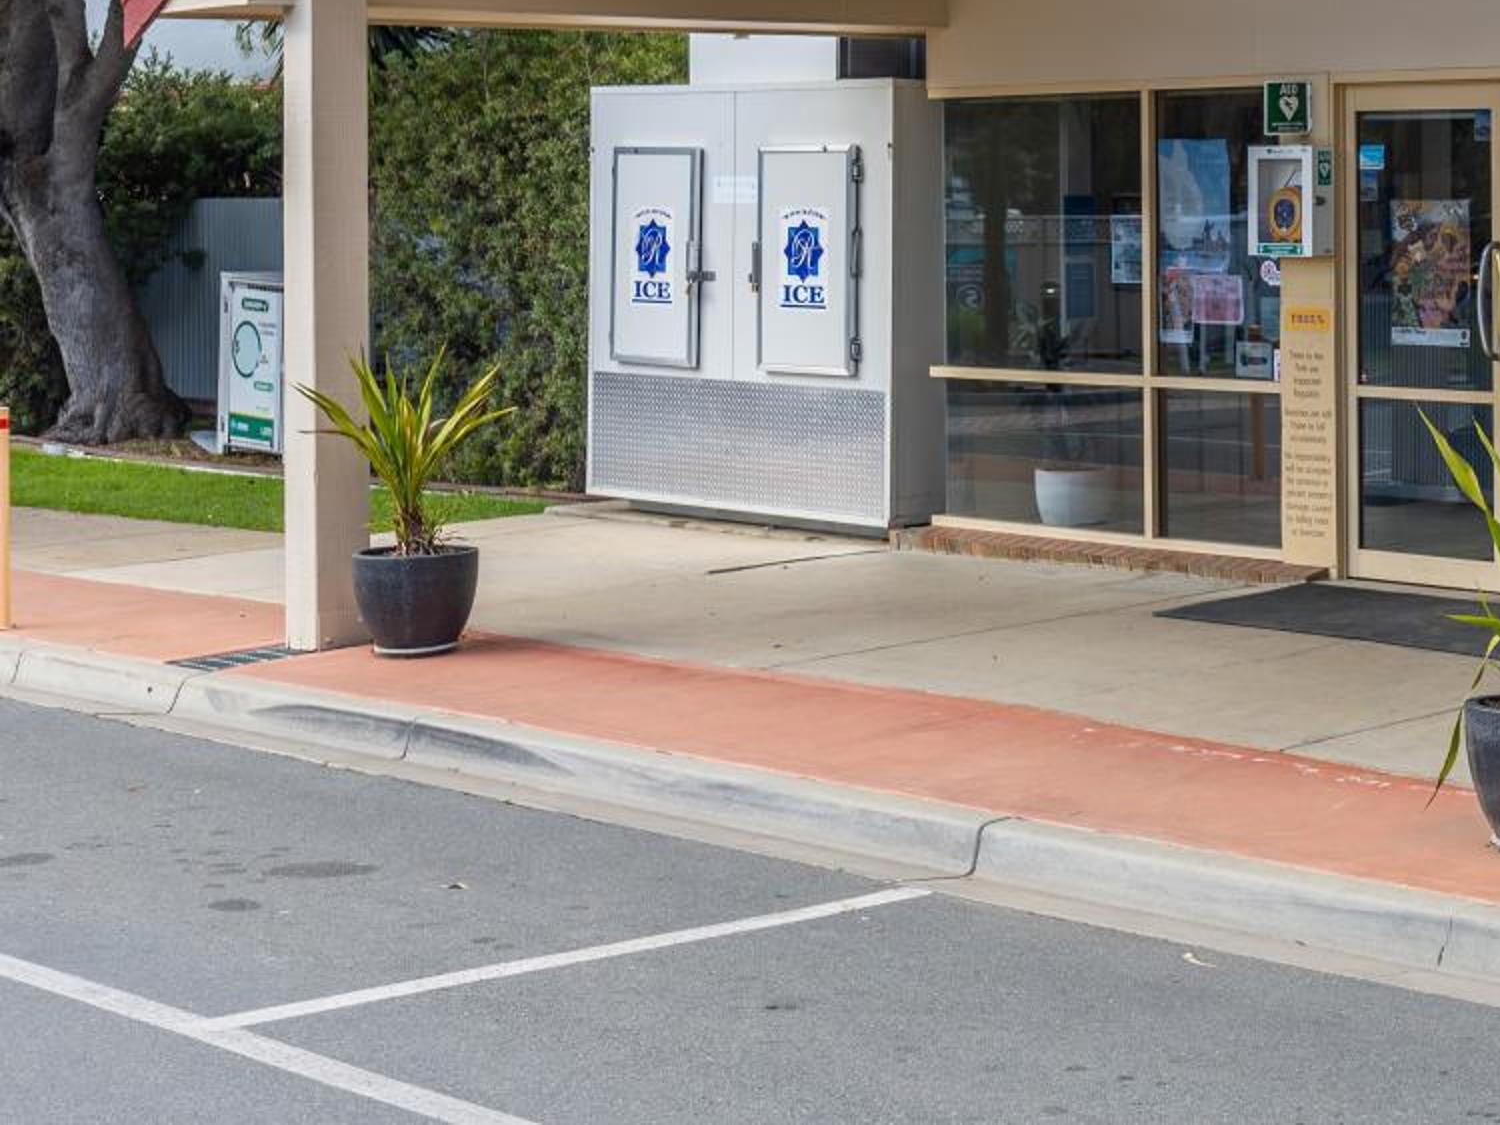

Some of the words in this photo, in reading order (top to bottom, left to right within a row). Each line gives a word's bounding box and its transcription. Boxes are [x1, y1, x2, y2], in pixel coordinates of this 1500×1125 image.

[1280, 84, 1298, 95] AED
[634, 281, 671, 299] ICE
[783, 285, 825, 304] ICE
